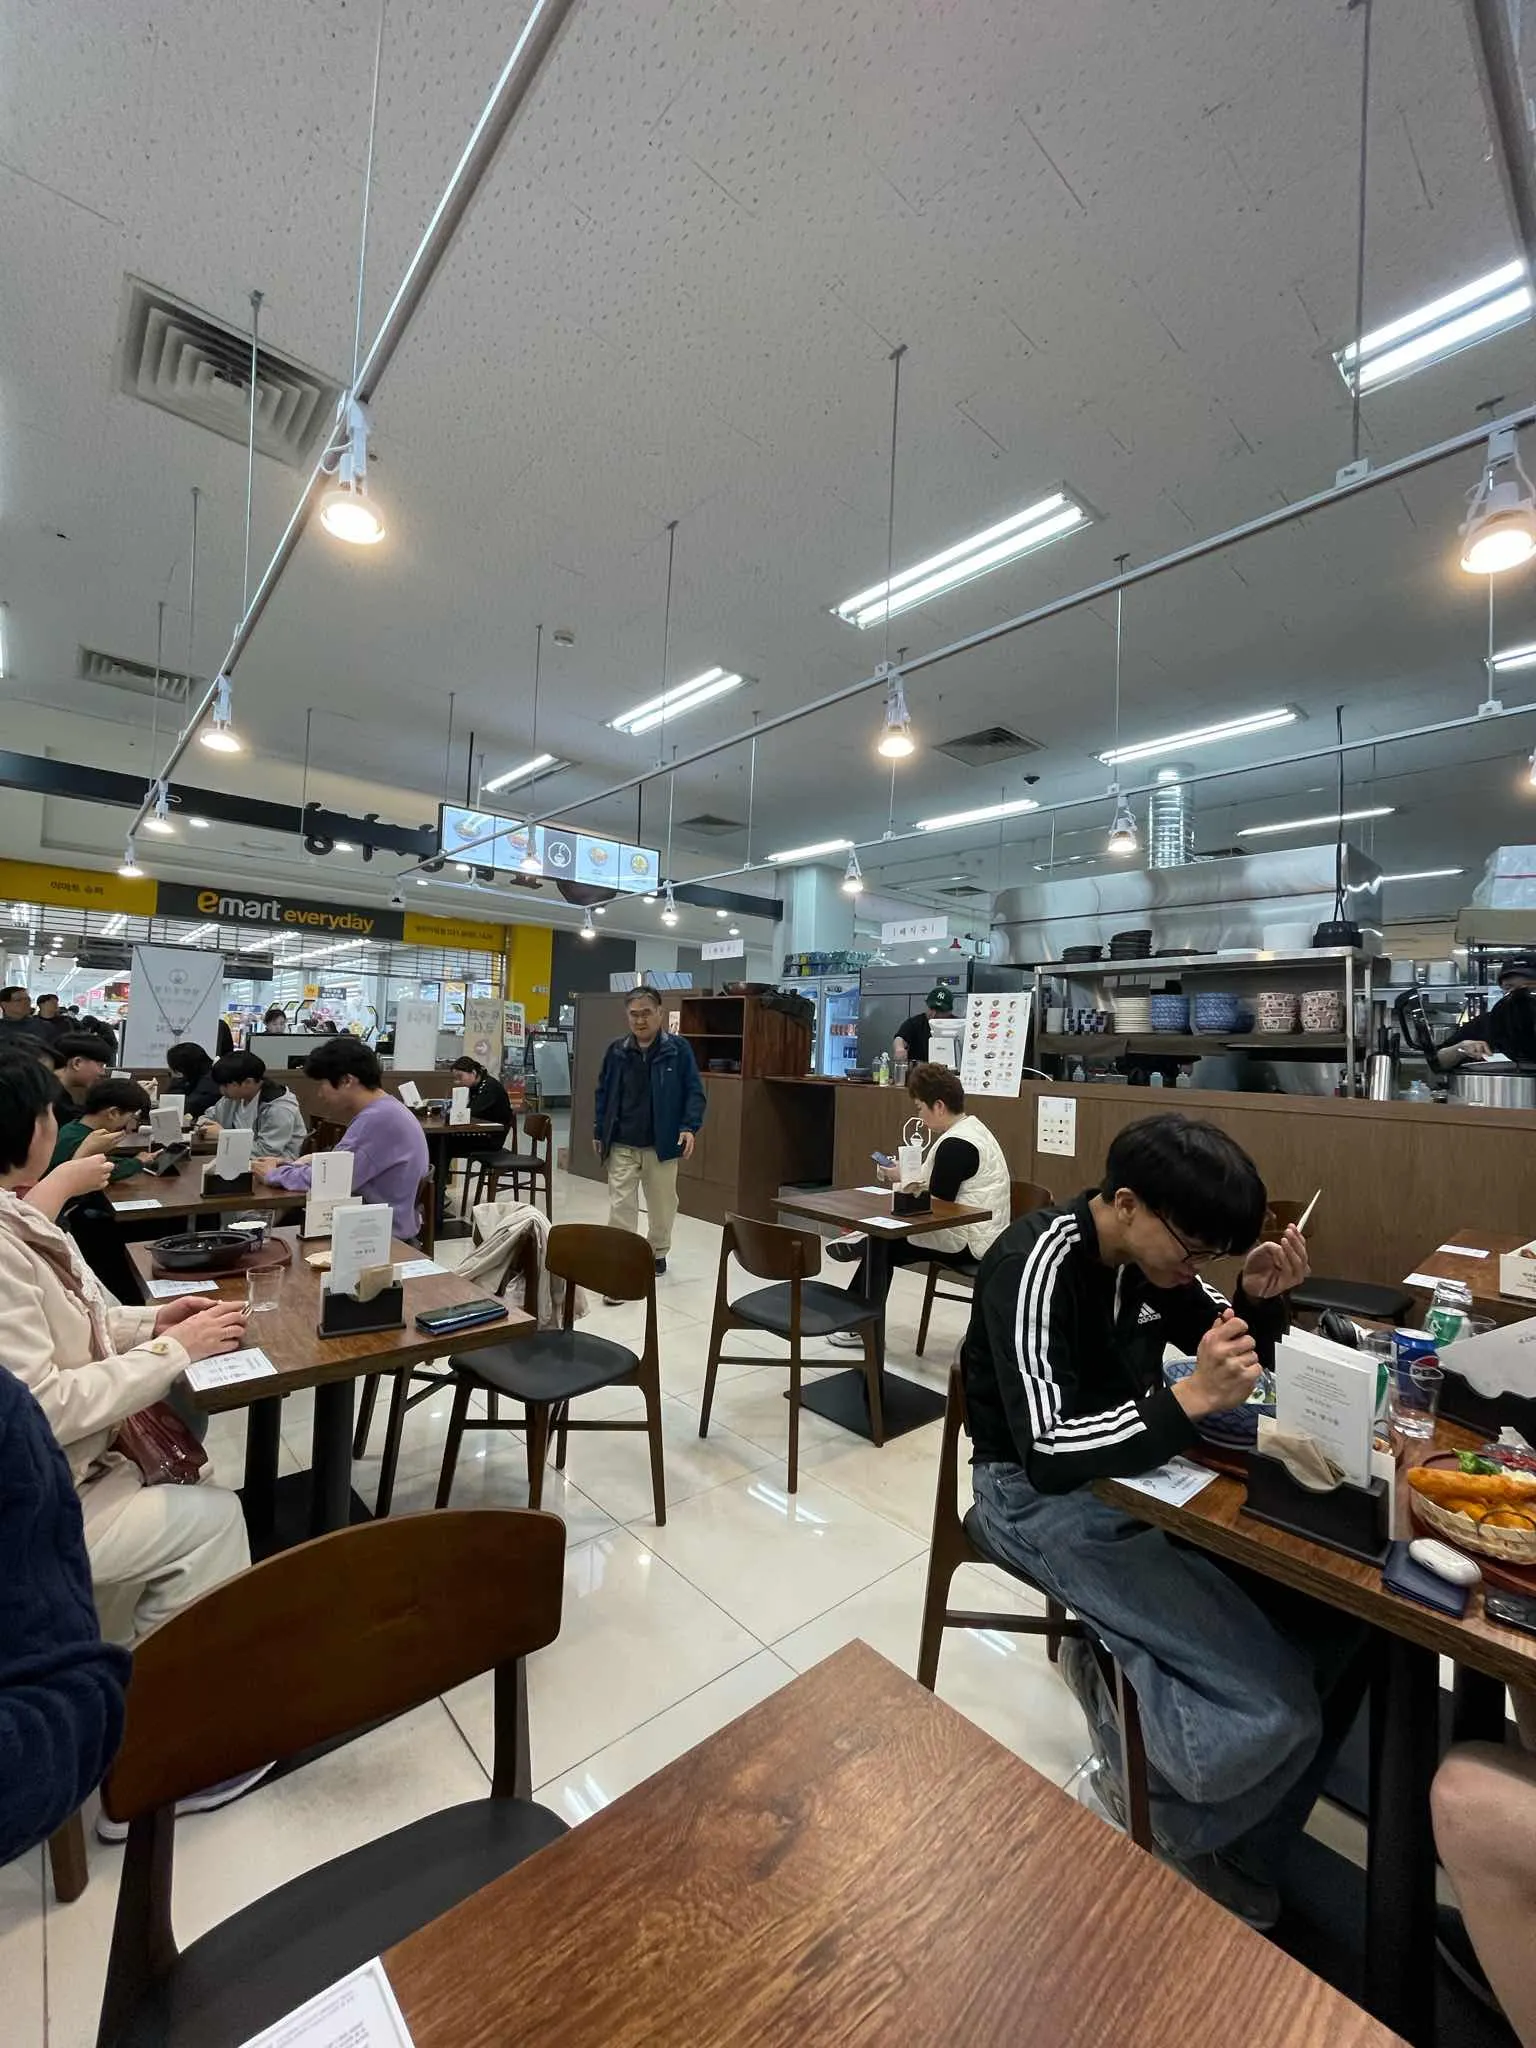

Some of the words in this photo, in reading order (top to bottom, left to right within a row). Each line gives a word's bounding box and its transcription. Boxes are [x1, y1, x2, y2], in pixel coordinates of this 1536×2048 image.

[197, 890, 281, 921] emart
[283, 908, 375, 933] everyday
[1137, 1312, 1162, 1325] adidas
